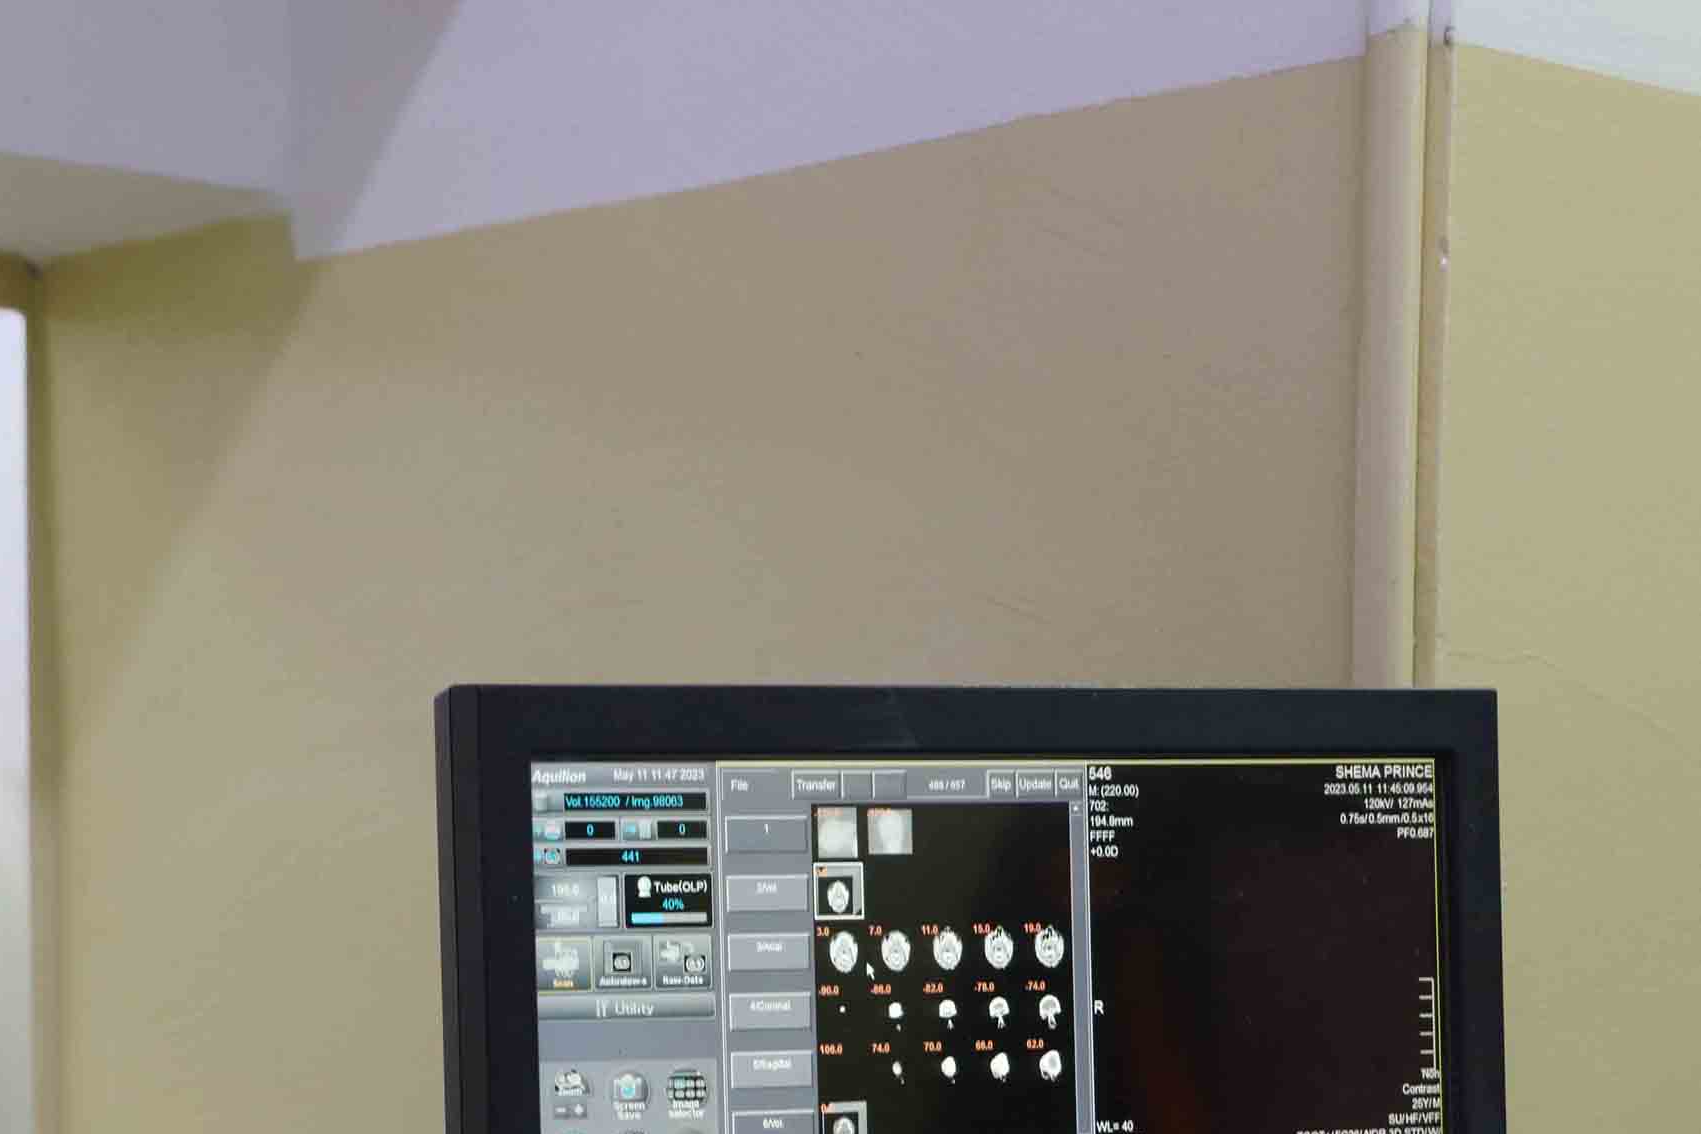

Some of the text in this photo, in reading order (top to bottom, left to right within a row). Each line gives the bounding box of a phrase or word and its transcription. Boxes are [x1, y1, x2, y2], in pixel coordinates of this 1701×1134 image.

[530, 769, 587, 785] Aquilion
[612, 768, 634, 782] May
[679, 768, 706, 781] 2023
[1335, 764, 1433, 779] SHEMA PRINCE
[730, 779, 749, 792] File
[797, 778, 836, 792] Transfer
[990, 778, 1012, 792] Skip
[1018, 778, 1052, 791] Update
[1058, 777, 1079, 790] Quit
[621, 850, 641, 863] 441
[653, 880, 708, 897] Tube(OLP)
[662, 897, 684, 911] 40%
[614, 1000, 655, 1017] Utility
[1094, 999, 1105, 1015] R
[1402, 1083, 1441, 1095] Contrast
[1121, 1119, 1134, 1132] 40
